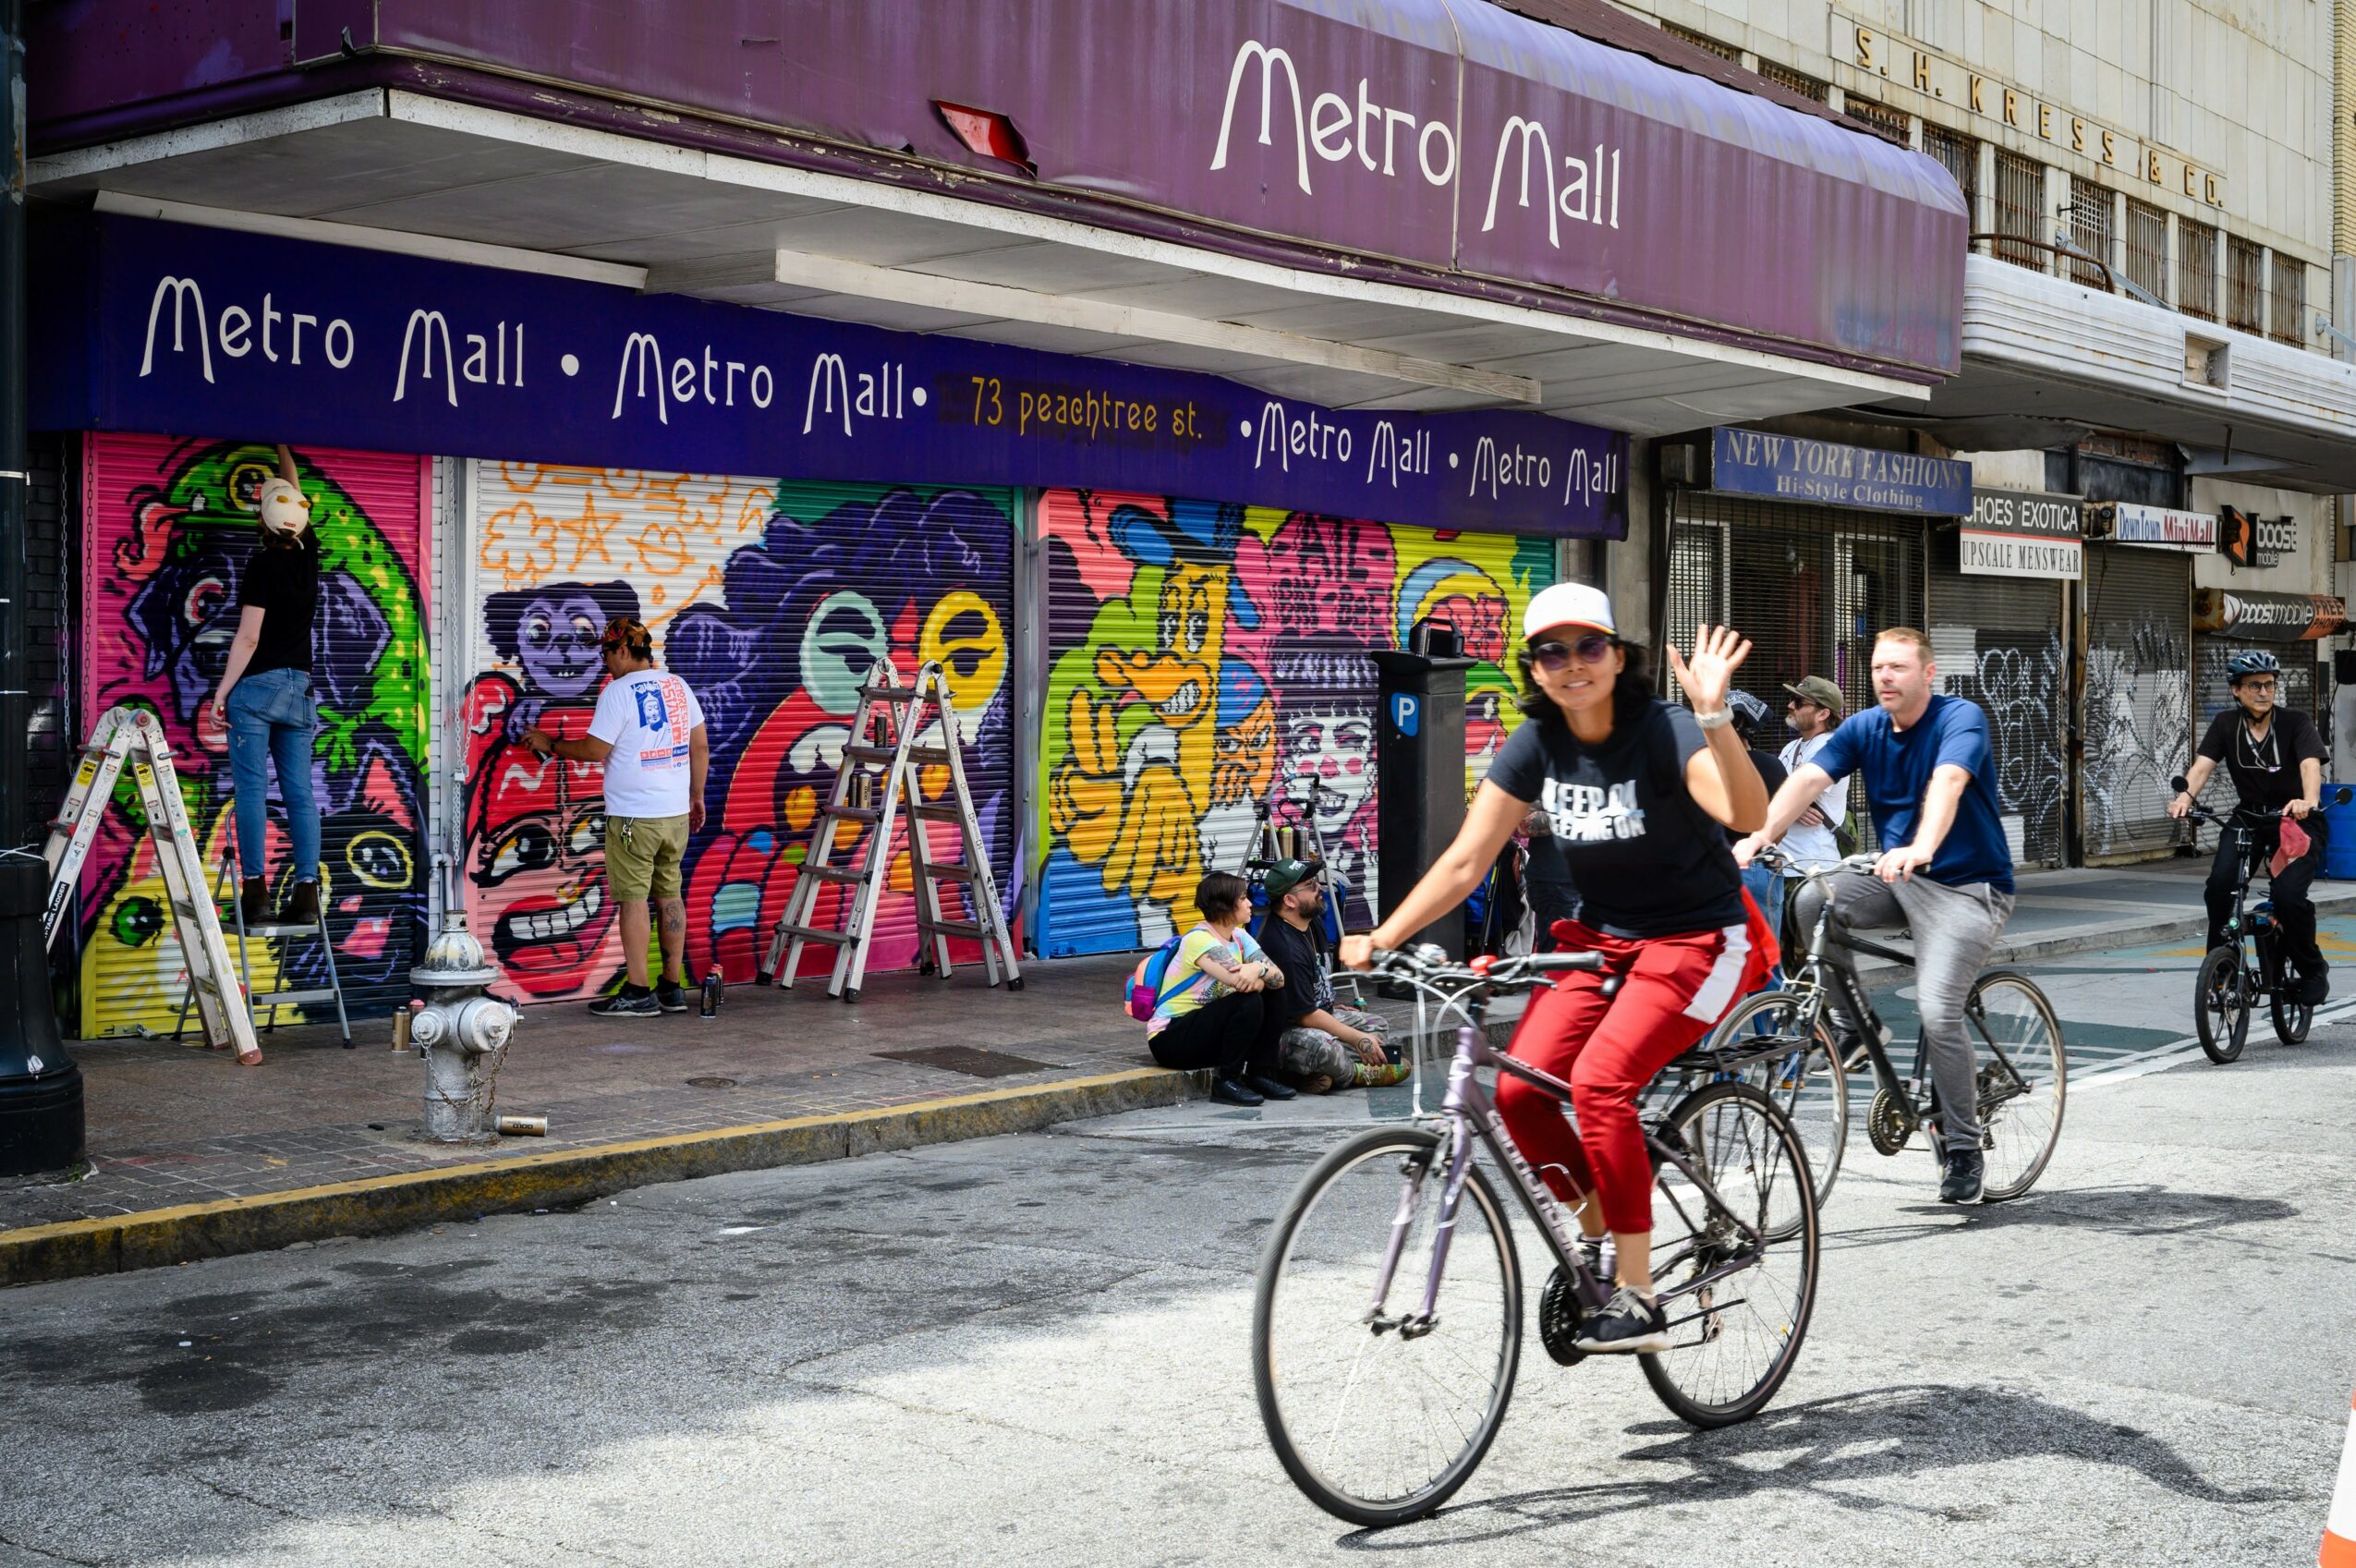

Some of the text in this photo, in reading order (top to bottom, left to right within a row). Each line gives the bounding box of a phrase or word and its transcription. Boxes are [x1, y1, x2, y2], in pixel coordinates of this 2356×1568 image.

[1209, 40, 1621, 249] Metro Mall
[1856, 28, 2225, 208] S. H. KRESS & CO.
[140, 275, 525, 407] Metro Mall
[612, 332, 904, 436] Metro Mall
[971, 376, 1203, 441] 73 peachtree st.
[1255, 402, 1430, 488] Metro Mall
[1469, 436, 1617, 507] Metro Mall
[1725, 431, 1964, 492] NEW YORK FASHIONS
[1776, 475, 1924, 509] Hi-Style Clothing
[1961, 540, 2080, 573] UPSCALE MENSWEAR
[2256, 514, 2297, 550] boost
[2256, 551, 2278, 565] mobile
[2313, 601, 2345, 616] FREE
[1398, 697, 1415, 726] P
